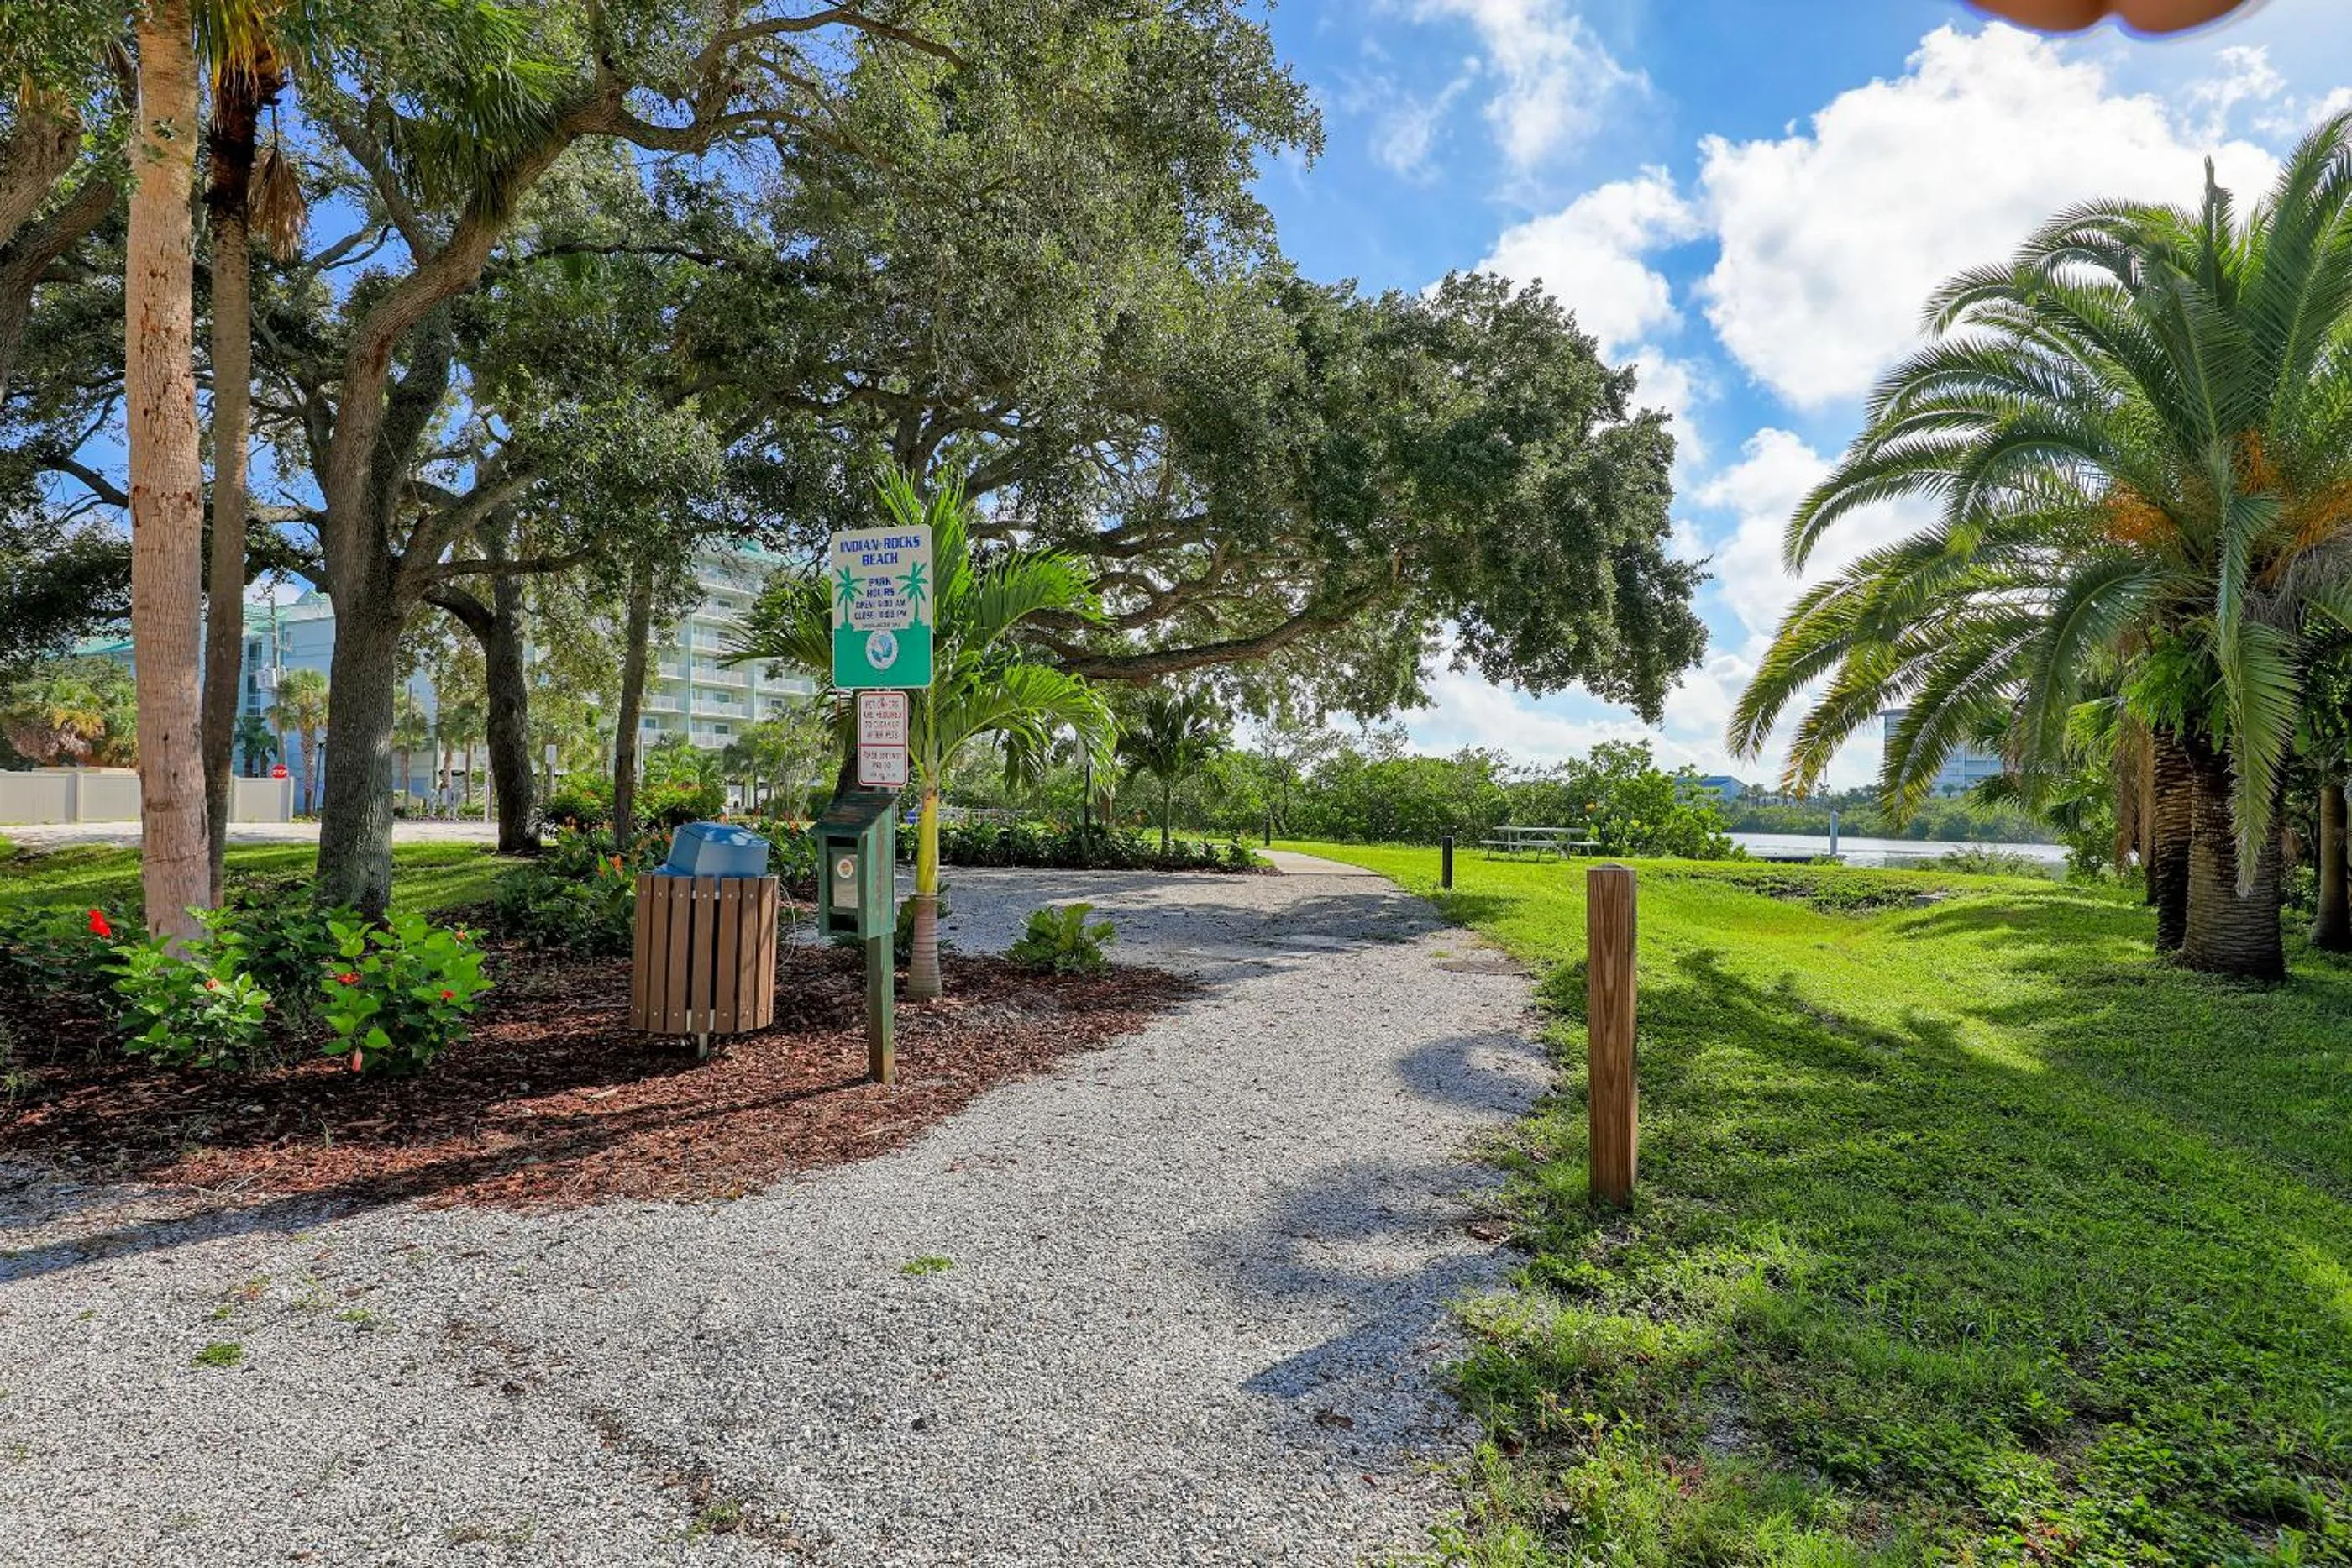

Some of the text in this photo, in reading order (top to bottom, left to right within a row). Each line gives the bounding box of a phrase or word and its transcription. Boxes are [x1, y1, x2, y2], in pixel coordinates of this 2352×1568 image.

[840, 536, 921, 553] INDIAN ROCKS
[862, 552, 898, 565] BEACH
[869, 577, 891, 586] PARK
[867, 587, 895, 597] HOURS
[895, 599, 906, 608] AM
[896, 609, 907, 618] PM
